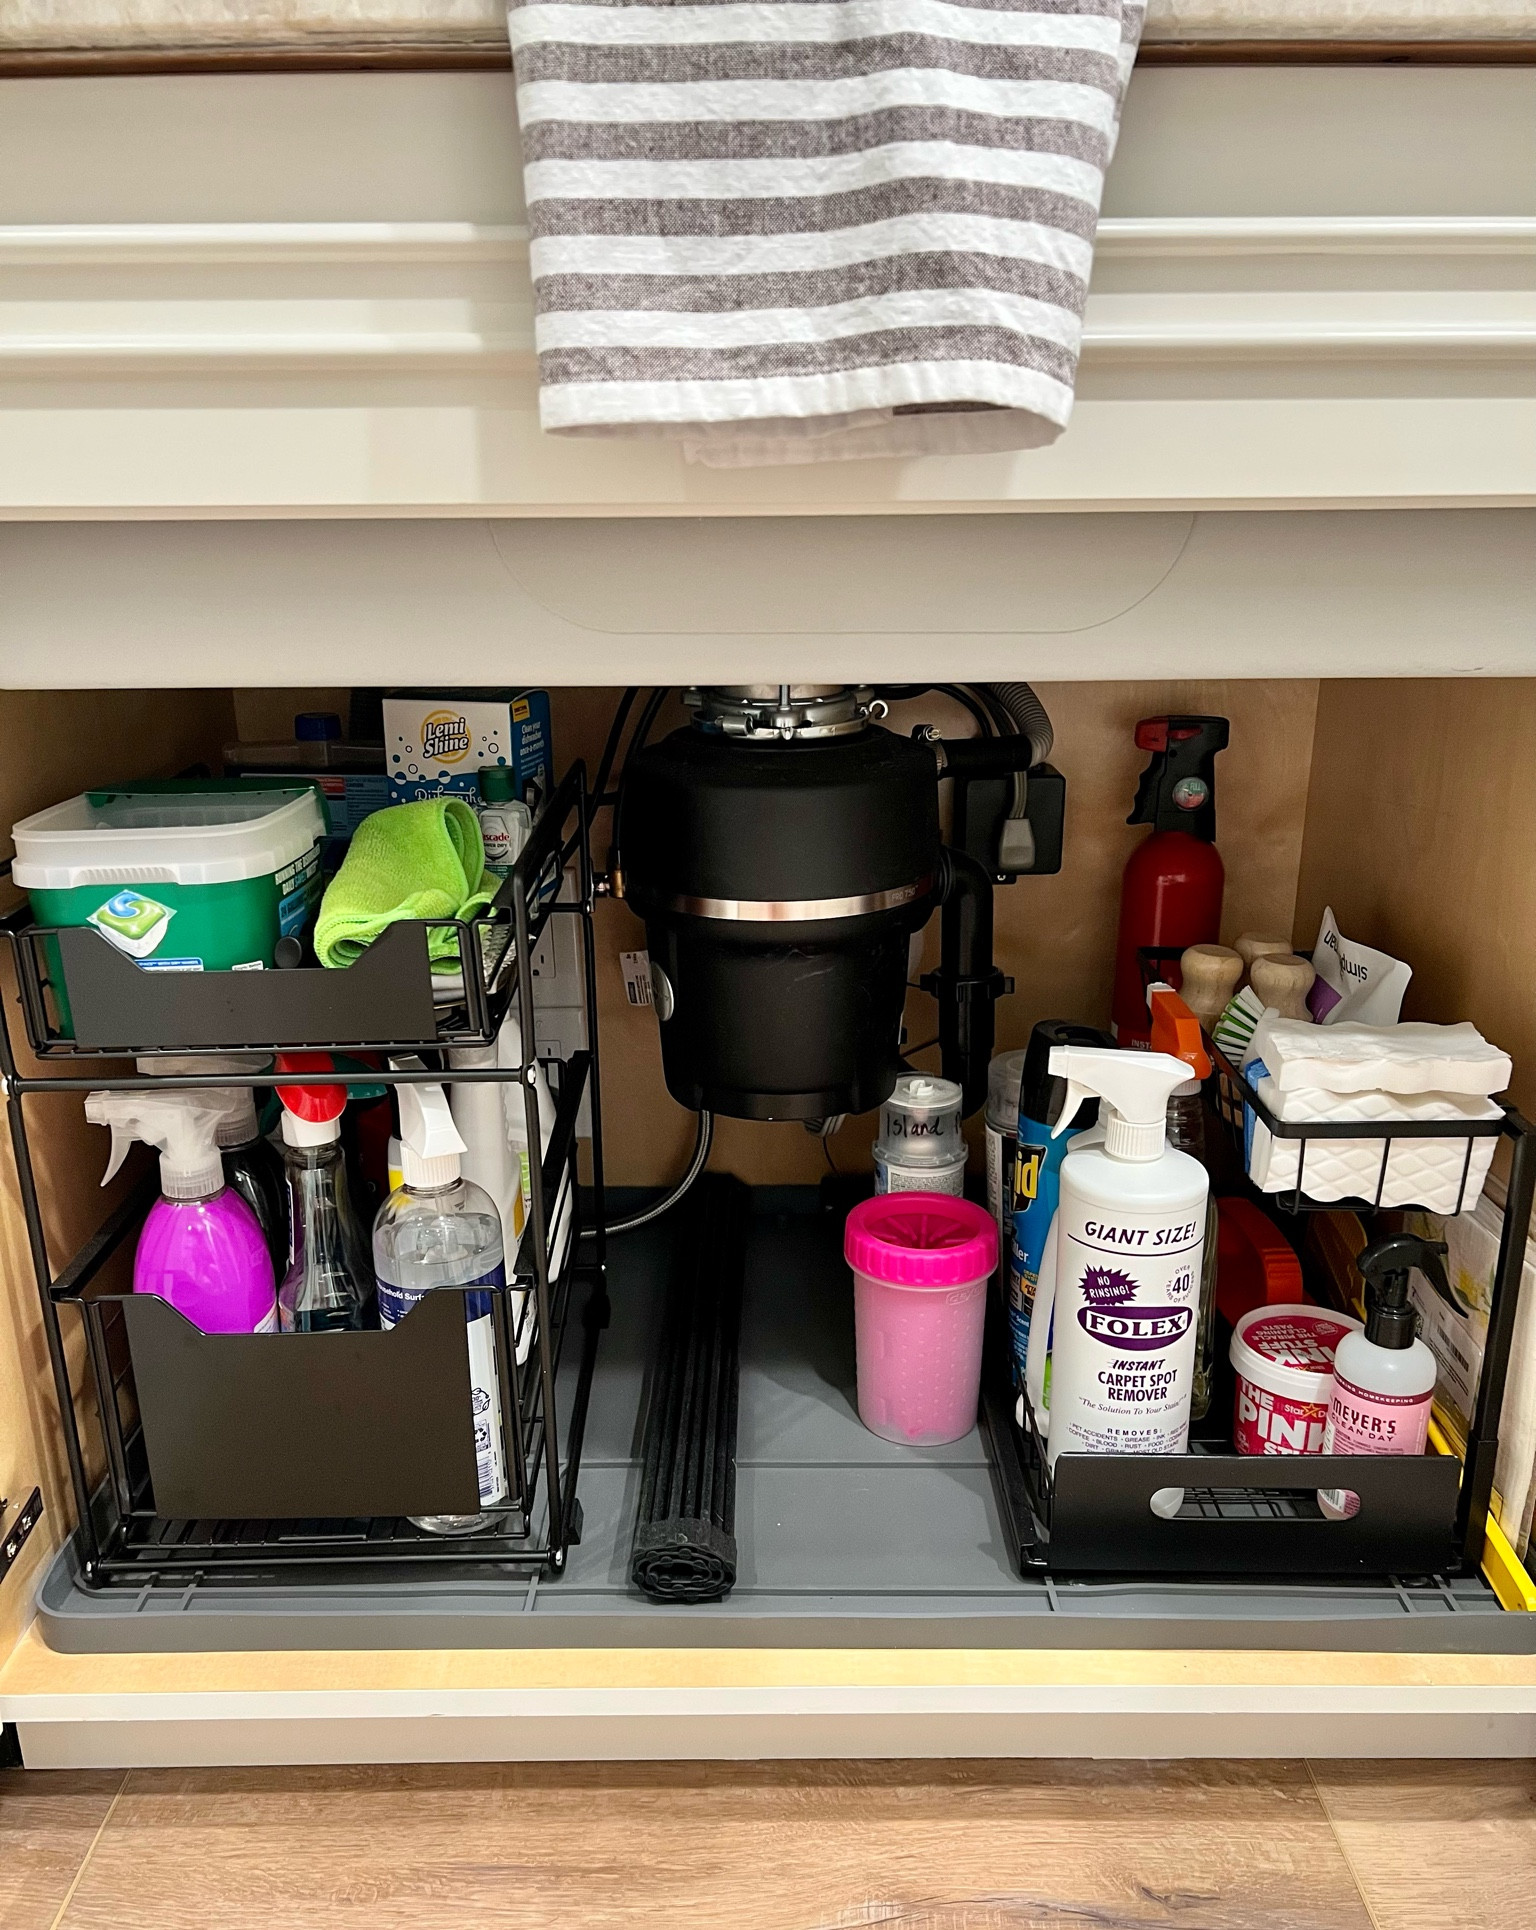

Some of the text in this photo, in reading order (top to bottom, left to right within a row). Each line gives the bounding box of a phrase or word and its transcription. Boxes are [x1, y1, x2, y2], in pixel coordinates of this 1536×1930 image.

[426, 717, 466, 740] Lemi
[423, 735, 469, 758] Shine
[483, 832, 510, 842] scade
[1131, 1038, 1152, 1050] INST
[886, 1112, 944, 1138] Island
[1014, 1151, 1039, 1199] id
[1085, 1221, 1197, 1246] GIANT SIZE!
[1175, 1264, 1191, 1275] OVER
[1097, 1275, 1110, 1286] NO
[1165, 1279, 1174, 1301] YEARS
[1172, 1273, 1190, 1294] 40
[1089, 1285, 1130, 1298] RINSING!
[1089, 1313, 1183, 1337] FOLEX
[1255, 1328, 1307, 1336] CLEANING
[1258, 1339, 1318, 1350] STUFF
[1111, 1359, 1166, 1371] INSTANT
[1262, 1346, 1335, 1365] INK
[1098, 1369, 1178, 1388] CARPET SPOT
[1108, 1386, 1168, 1402] REMOVER
[1240, 1376, 1274, 1411] THE
[1358, 1390, 1414, 1403] HOMEKEEPING
[1098, 1403, 1131, 1415] Solution
[1133, 1407, 1143, 1415] To
[1146, 1406, 1162, 1415] Your
[1284, 1403, 1304, 1415] Star
[1333, 1397, 1397, 1434] MEYER'S
[1238, 1390, 1327, 1452] PINK
[1332, 1412, 1364, 1437] CLEAN
[1368, 1433, 1395, 1442] DAY
[1068, 1428, 1090, 1442] COFFEE
[1096, 1438, 1118, 1448] BLOOD
[1147, 1440, 1164, 1448] FOOD
[1072, 1423, 1082, 1431] PET
[1083, 1428, 1118, 1441] ACCIDENTS
[1085, 1441, 1099, 1451] DIRT
[1152, 1446, 1163, 1454] OLD
